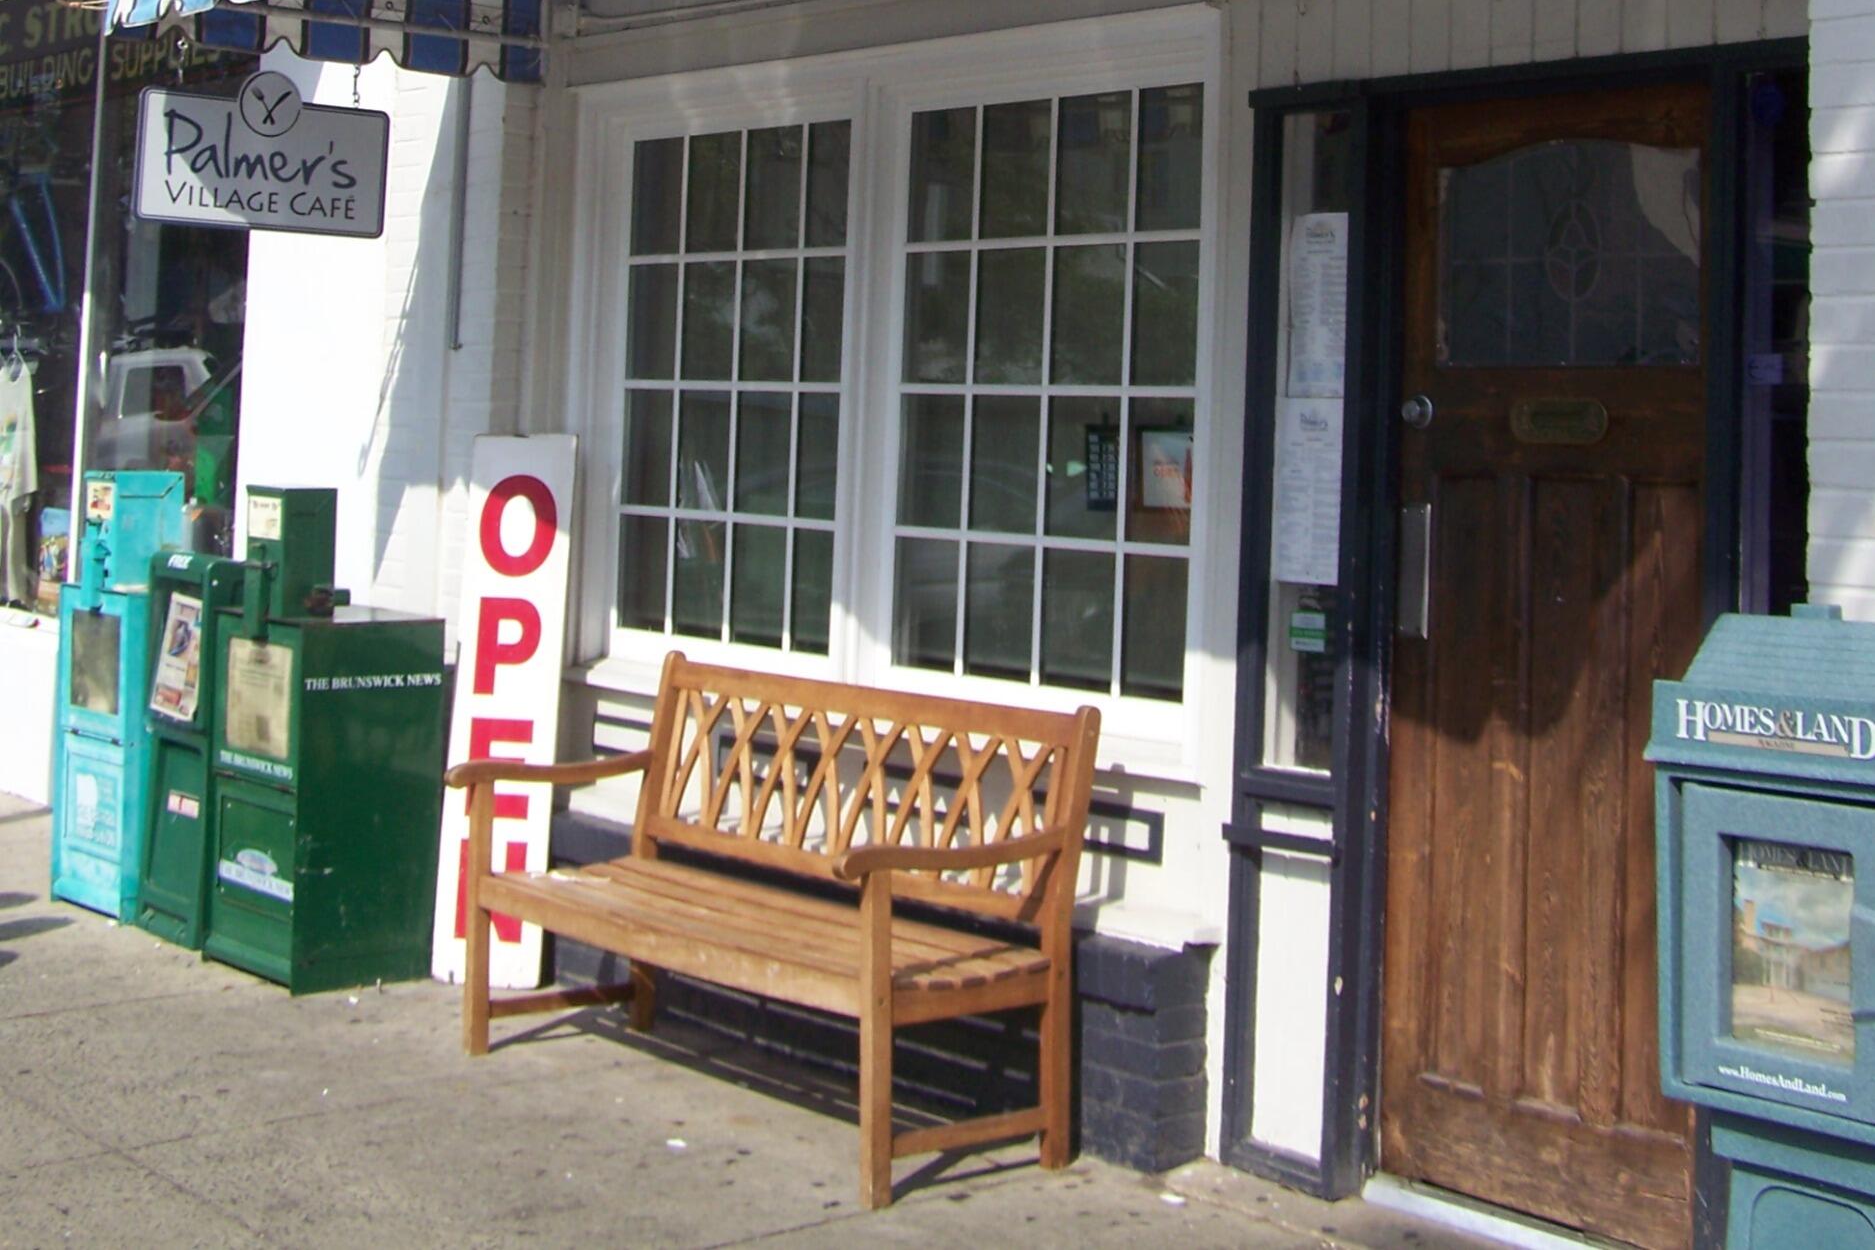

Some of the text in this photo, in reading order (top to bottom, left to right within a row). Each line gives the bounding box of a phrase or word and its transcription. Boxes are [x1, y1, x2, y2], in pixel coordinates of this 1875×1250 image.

[163, 108, 357, 189] Palmer's
[164, 179, 356, 220] VILLAGE CAFÉ
[304, 672, 442, 690] THE BRUNSWICK NEWS
[454, 474, 557, 943] OPEN
[1718, 1065, 1847, 1102] www.HomesAndLand.com
